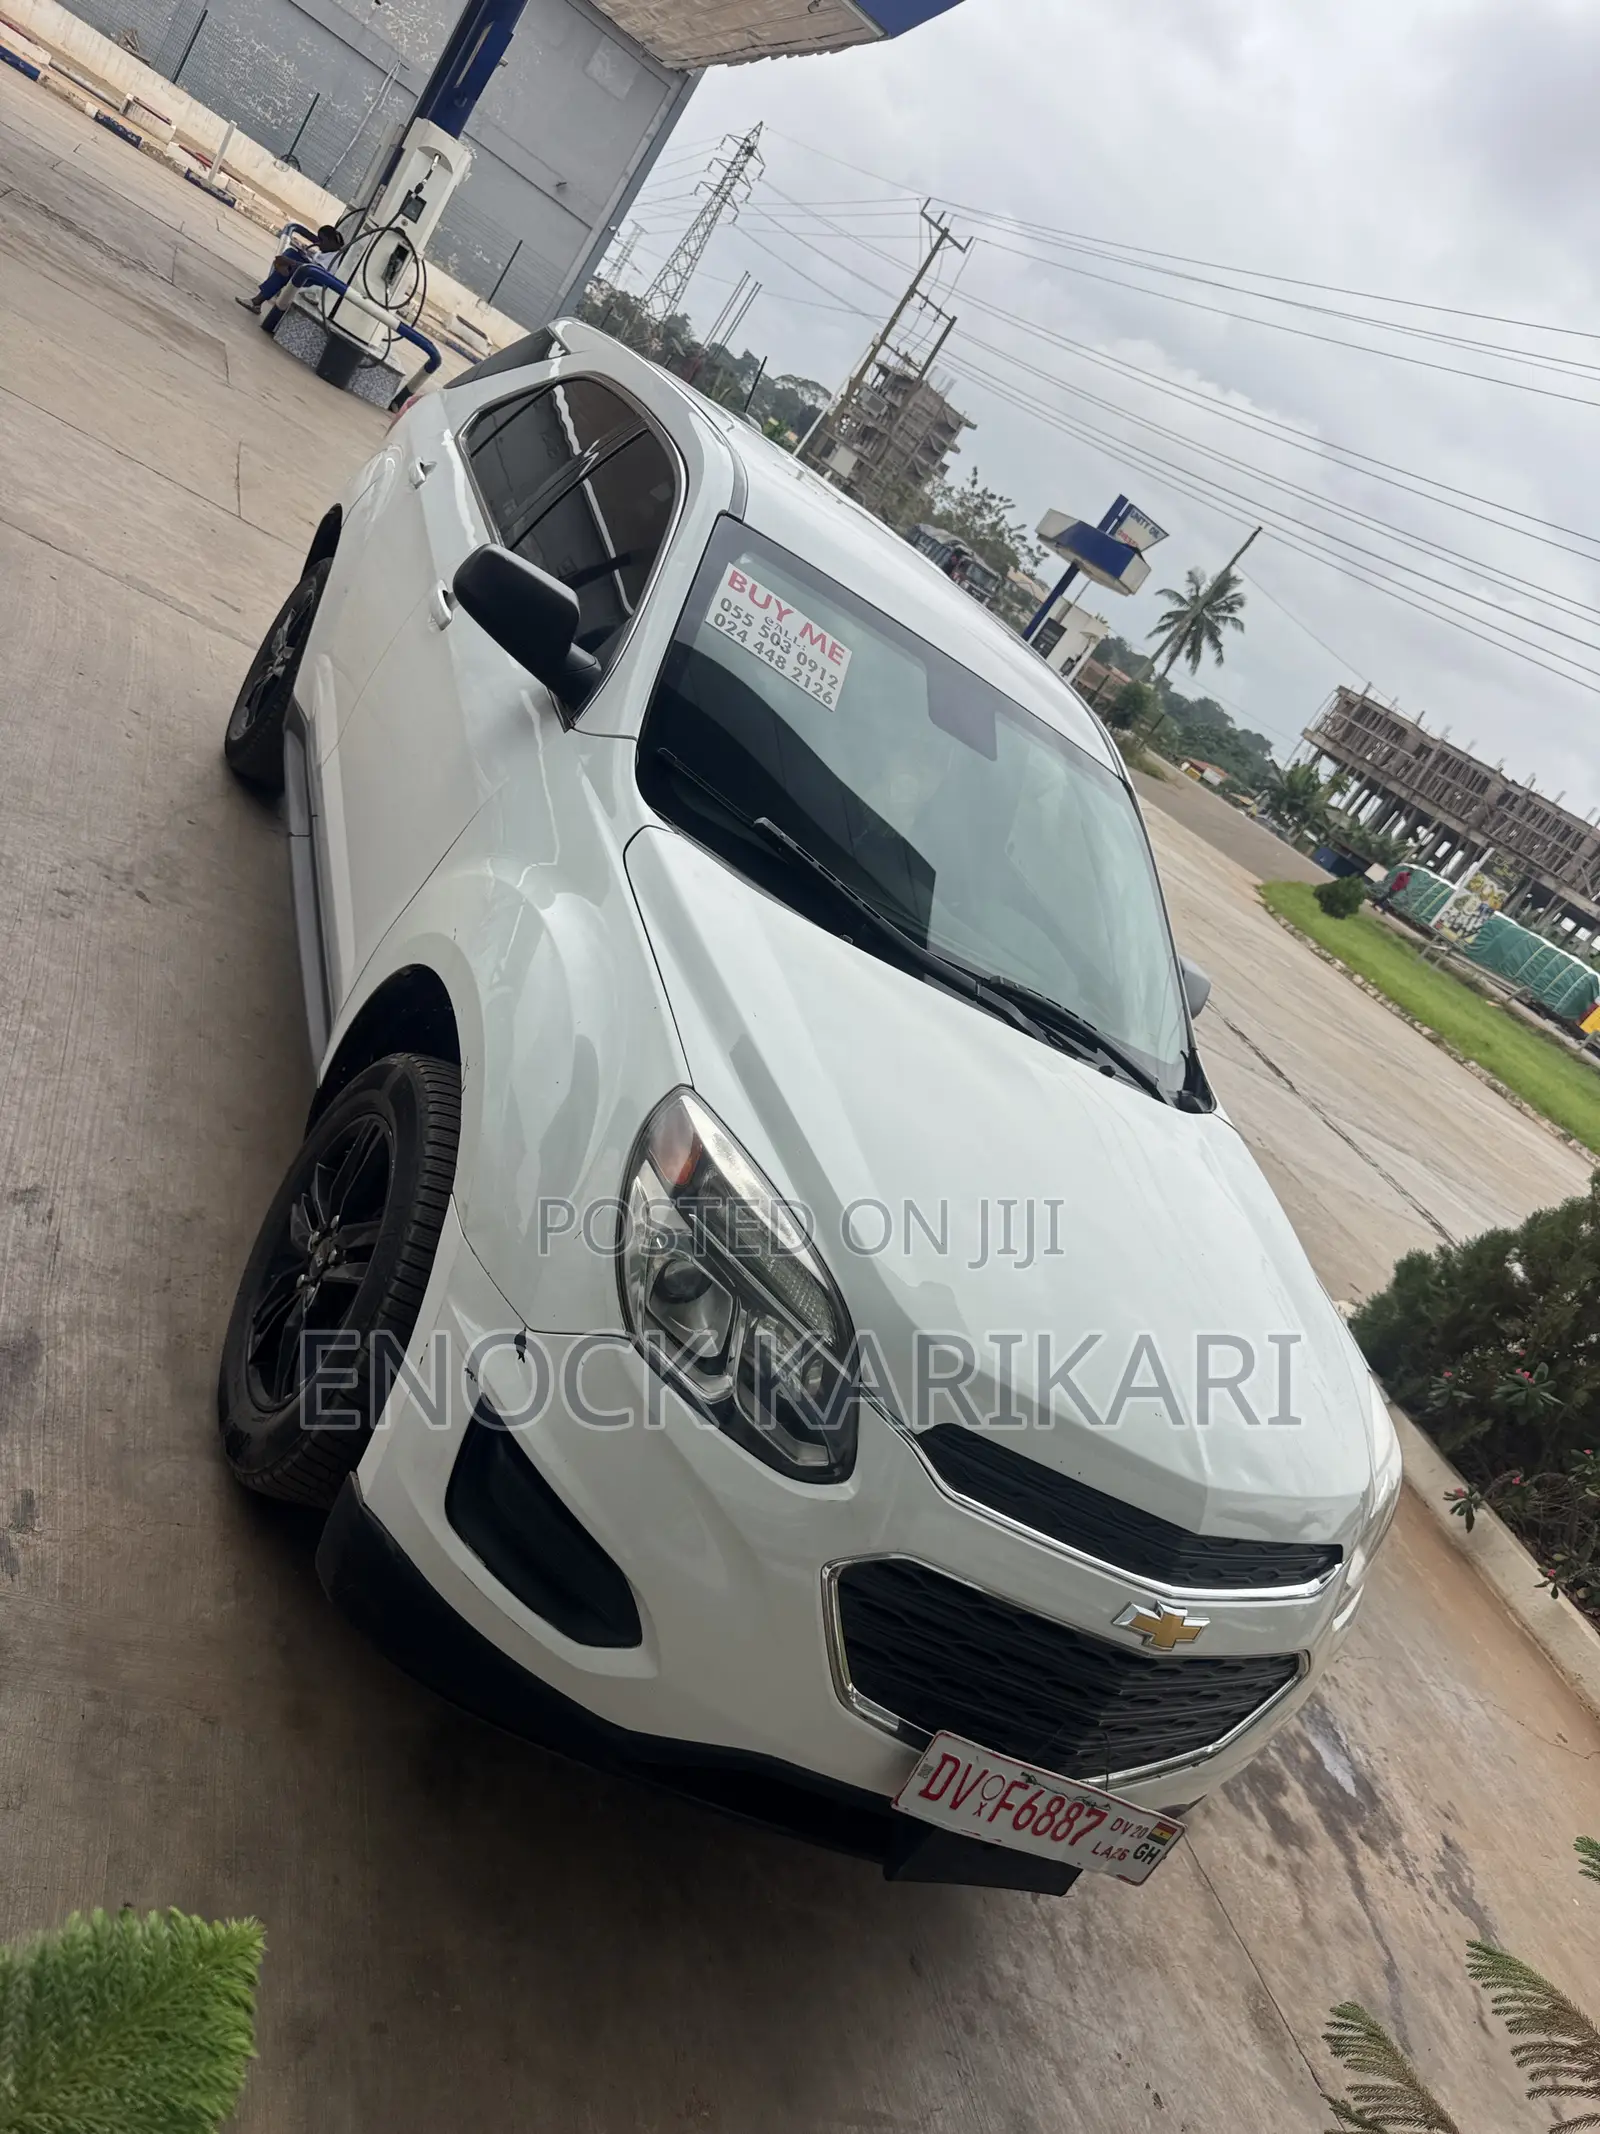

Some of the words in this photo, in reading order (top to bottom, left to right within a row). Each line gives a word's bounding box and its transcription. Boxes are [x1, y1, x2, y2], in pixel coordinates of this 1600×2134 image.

[713, 612, 749, 643] 024
[753, 640, 787, 670] 448
[790, 666, 833, 705] 2126
[720, 597, 755, 628] 055
[758, 624, 792, 654] 503
[796, 651, 839, 690] 0912
[728, 569, 794, 623] BUY
[799, 622, 846, 666] ME
[1110, 1817, 1134, 1835] DV
[1133, 1843, 1161, 1865] GH
